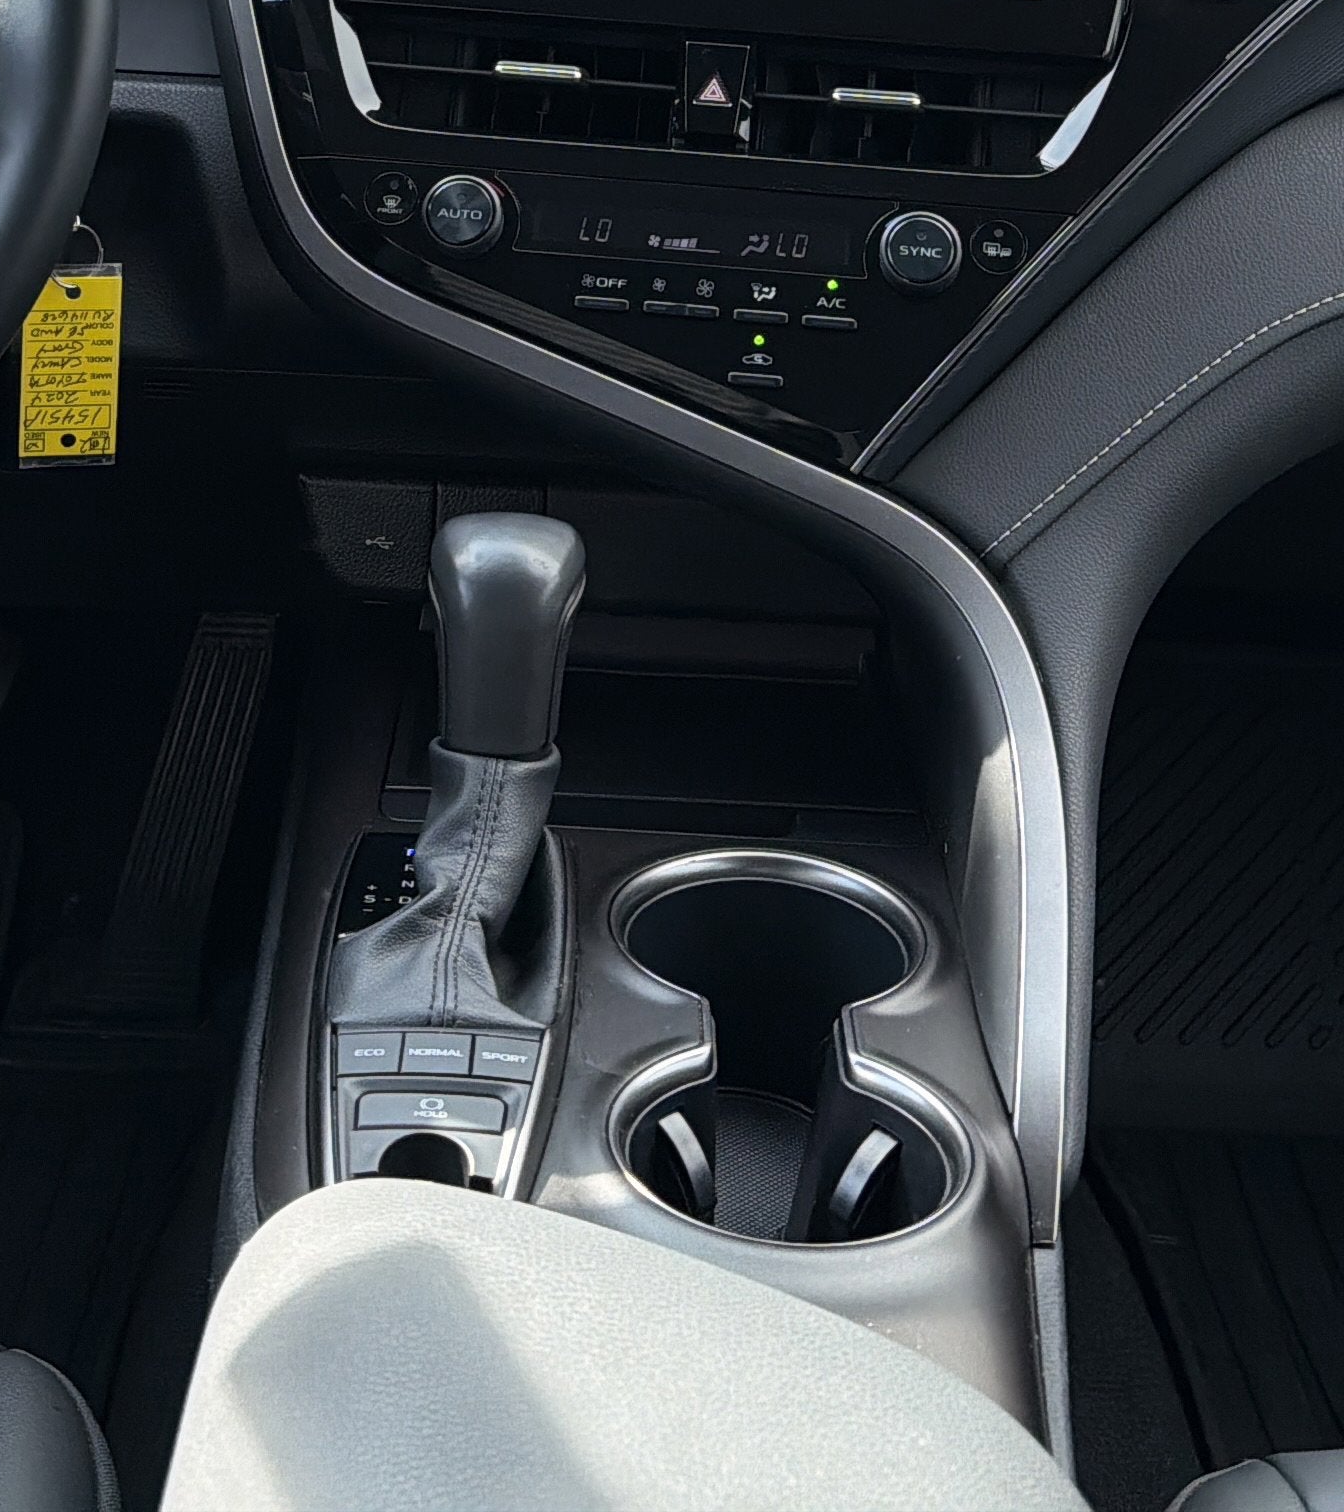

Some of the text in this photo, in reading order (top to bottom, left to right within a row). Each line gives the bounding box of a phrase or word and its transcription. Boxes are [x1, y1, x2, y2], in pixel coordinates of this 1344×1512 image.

[436, 207, 483, 220] AUTO
[898, 245, 943, 259] SYNC
[595, 275, 628, 290] OFF
[816, 295, 847, 310] A/C
[90, 339, 114, 347] BODY
[91, 430, 110, 438] NEW
[401, 879, 415, 888] N
[398, 896, 413, 905] D
[354, 1048, 386, 1057] ECO
[408, 1048, 464, 1059] NORMAL
[481, 1051, 528, 1064] SPORT
[413, 1109, 448, 1119] HOLD
